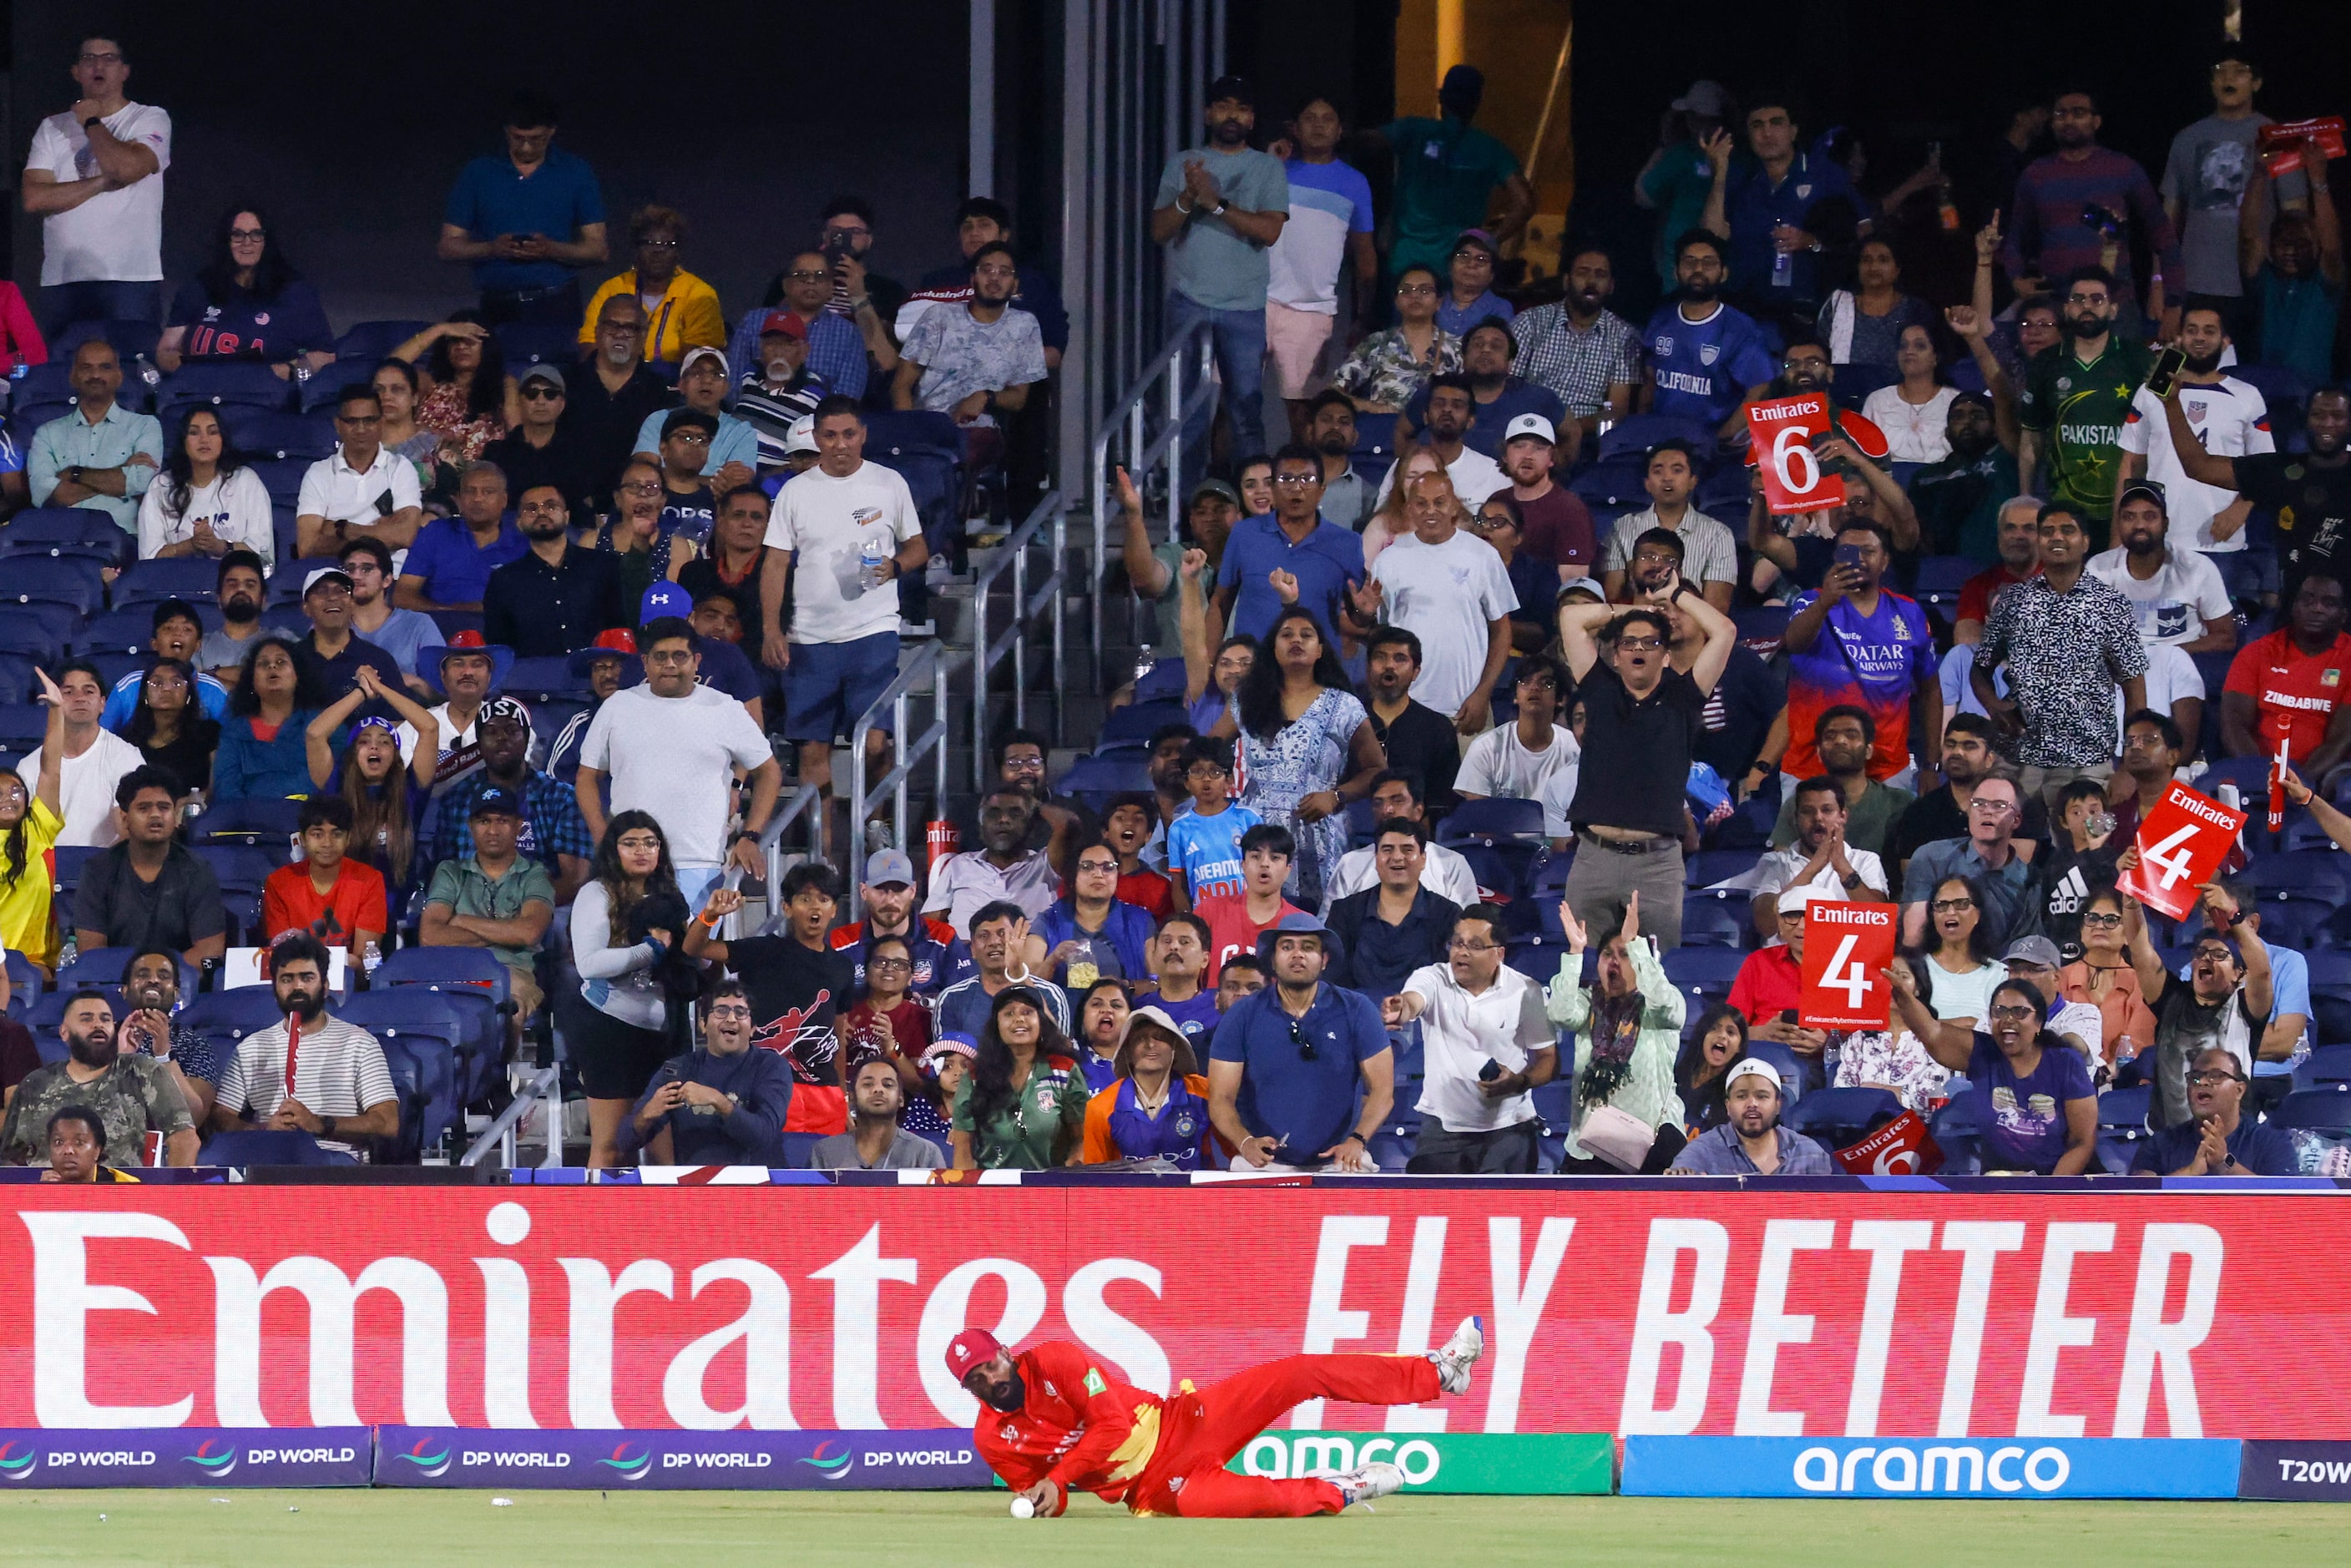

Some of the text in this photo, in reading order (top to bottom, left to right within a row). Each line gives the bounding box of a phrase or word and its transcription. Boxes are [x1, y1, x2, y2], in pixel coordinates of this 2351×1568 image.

[1655, 336, 1674, 356] 99
[1751, 402, 1821, 422] Emirates
[1772, 425, 1821, 494] 6
[1846, 644, 1904, 662] QATAR
[1859, 660, 1904, 672] AIRWAYS
[2263, 690, 2332, 712] ZIMBABWE
[480, 701, 524, 727] USA
[2169, 787, 2237, 831] Emirates
[2142, 823, 2202, 892] 4
[1813, 905, 1889, 926] Emirates
[2049, 896, 2082, 915] adid
[1818, 934, 1873, 1009] 4
[1843, 1115, 1911, 1161] Emirates
[1873, 1138, 1921, 1176] 6
[17, 1201, 1171, 1429] Emirates
[1290, 1215, 2225, 1439] FLY BETTER
[48, 1451, 156, 1467] DP WORLD
[247, 1448, 356, 1464] DP WORLD
[463, 1451, 571, 1467] DP WORLD
[663, 1453, 772, 1468] DP WORLD
[864, 1450, 973, 1466] DP WORLD
[1242, 1435, 1441, 1485] amco
[1792, 1447, 2070, 1493] aramco
